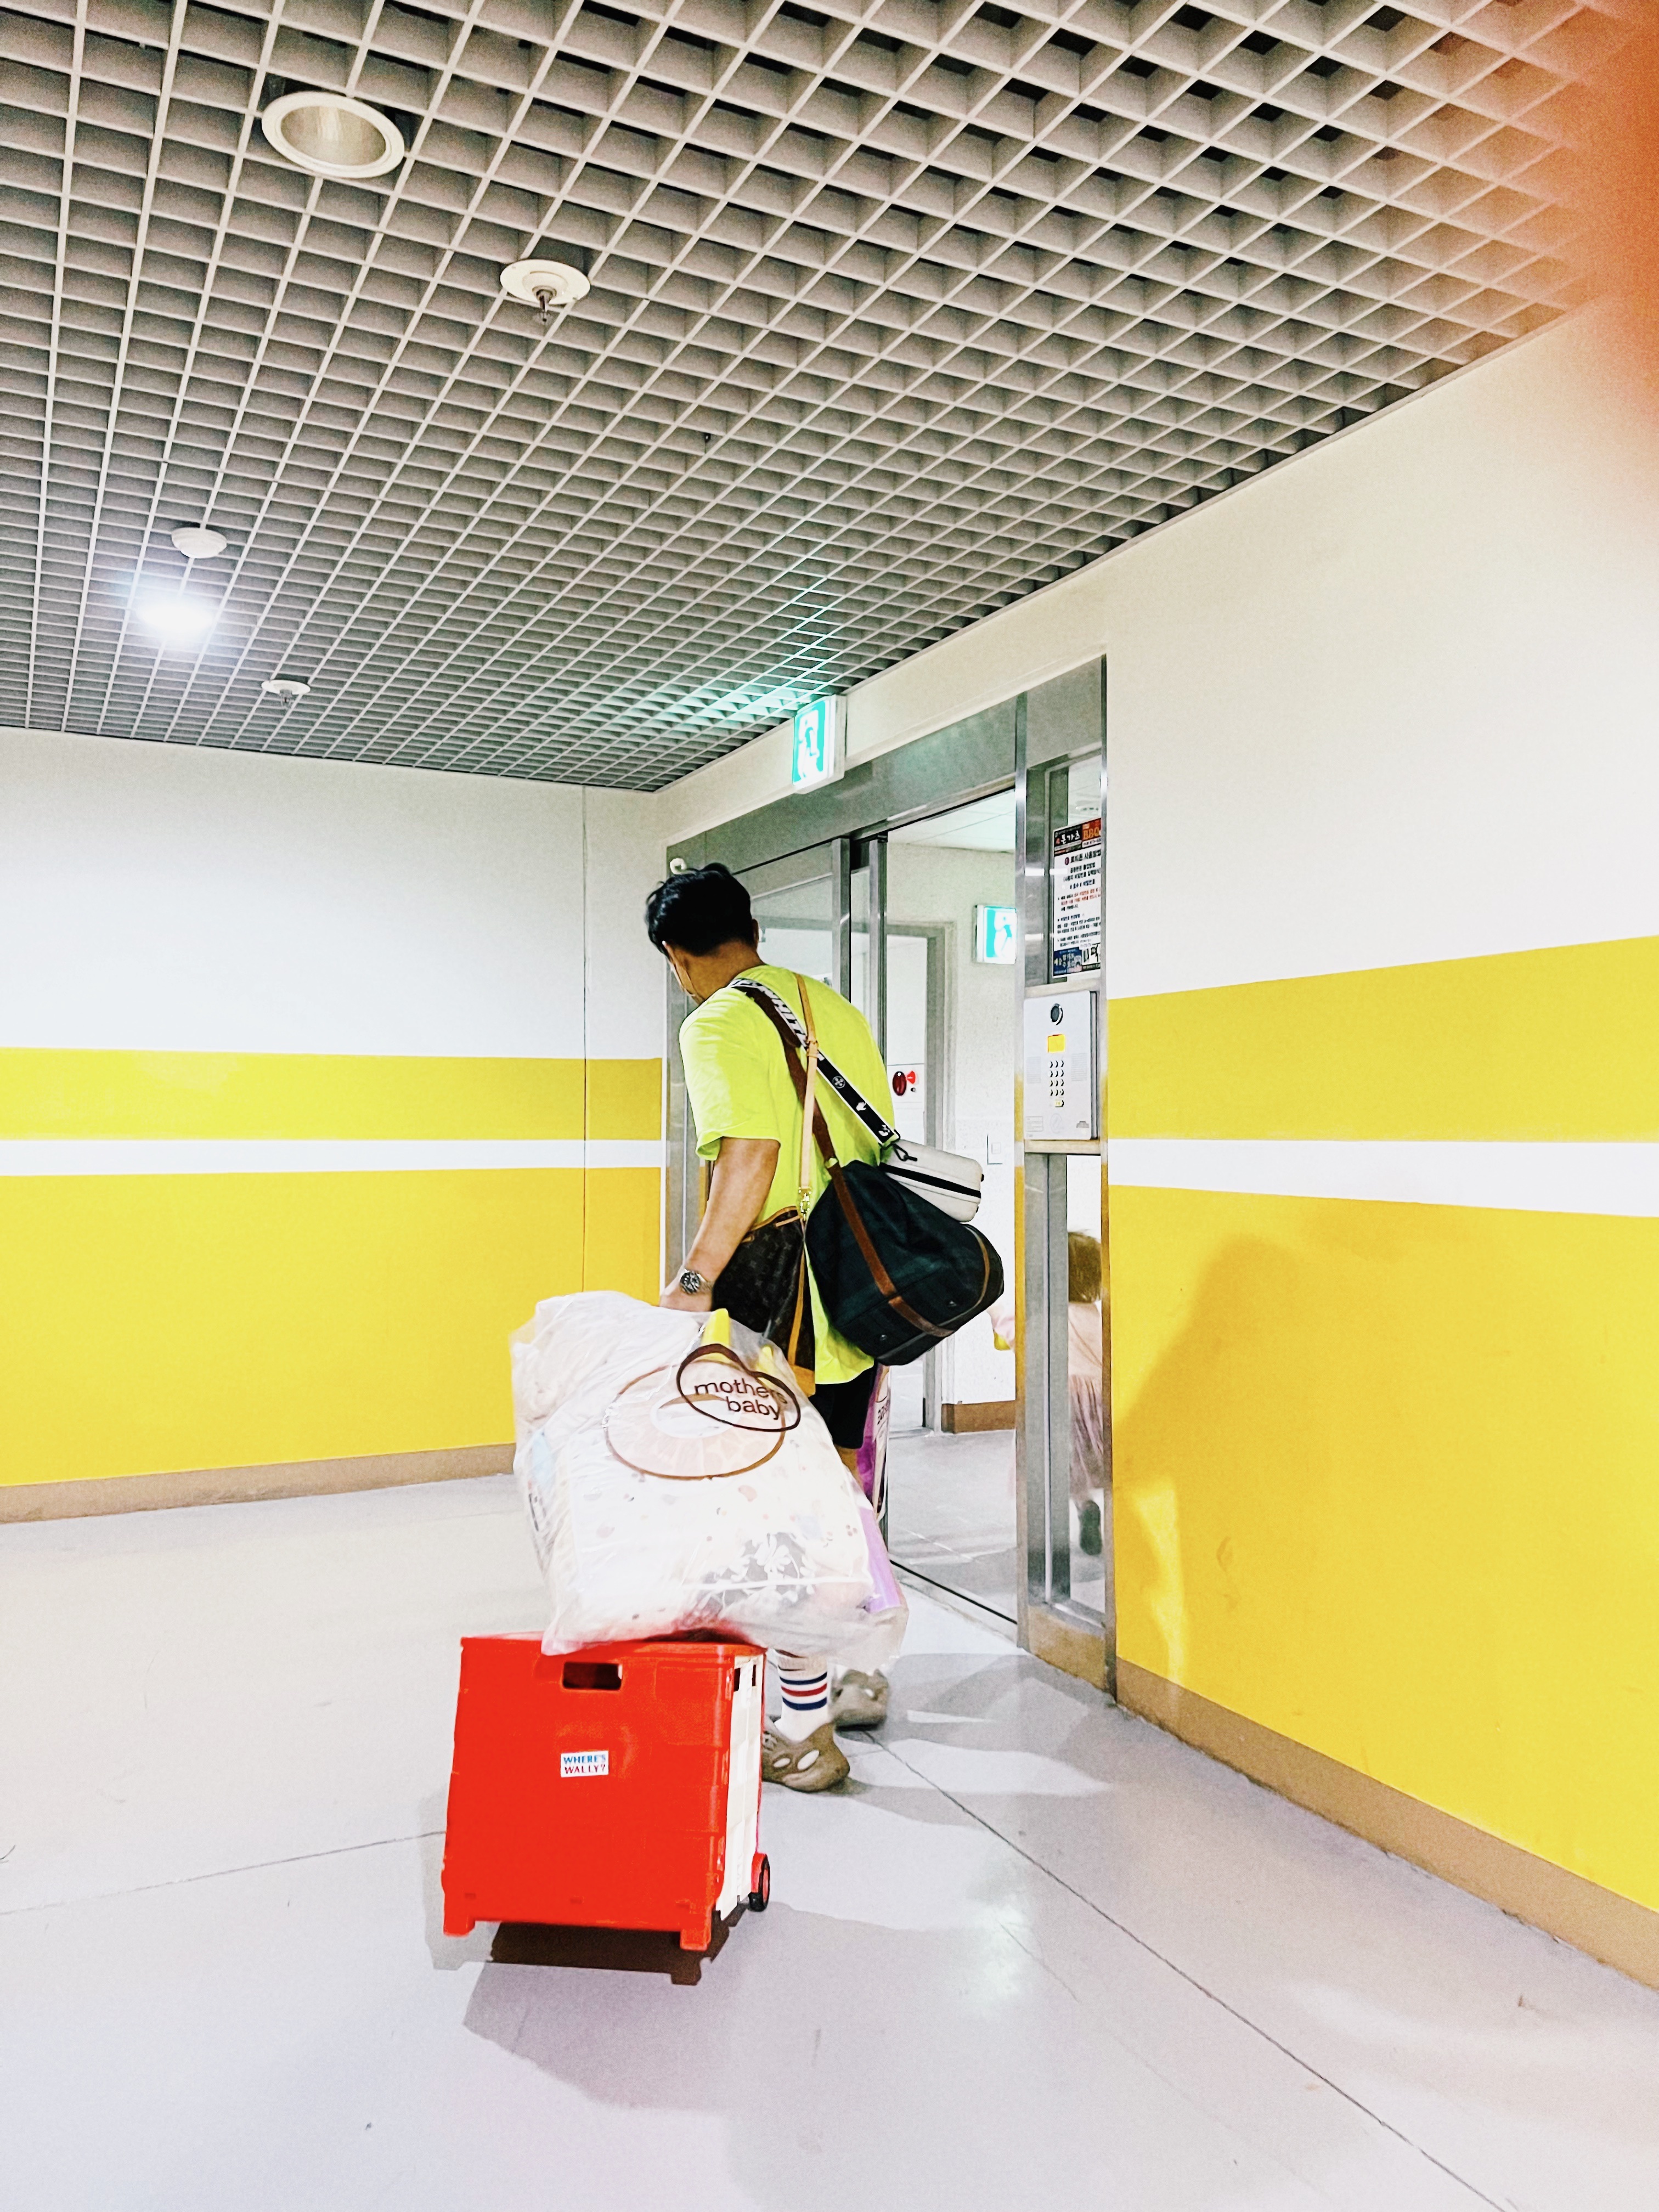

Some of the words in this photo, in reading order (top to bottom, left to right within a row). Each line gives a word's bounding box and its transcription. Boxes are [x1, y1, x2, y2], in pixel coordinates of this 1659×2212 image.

[726, 1396, 780, 1420] baby
[563, 1754, 606, 1764] WHERE'S
[565, 1764, 606, 1774] WALLY?
